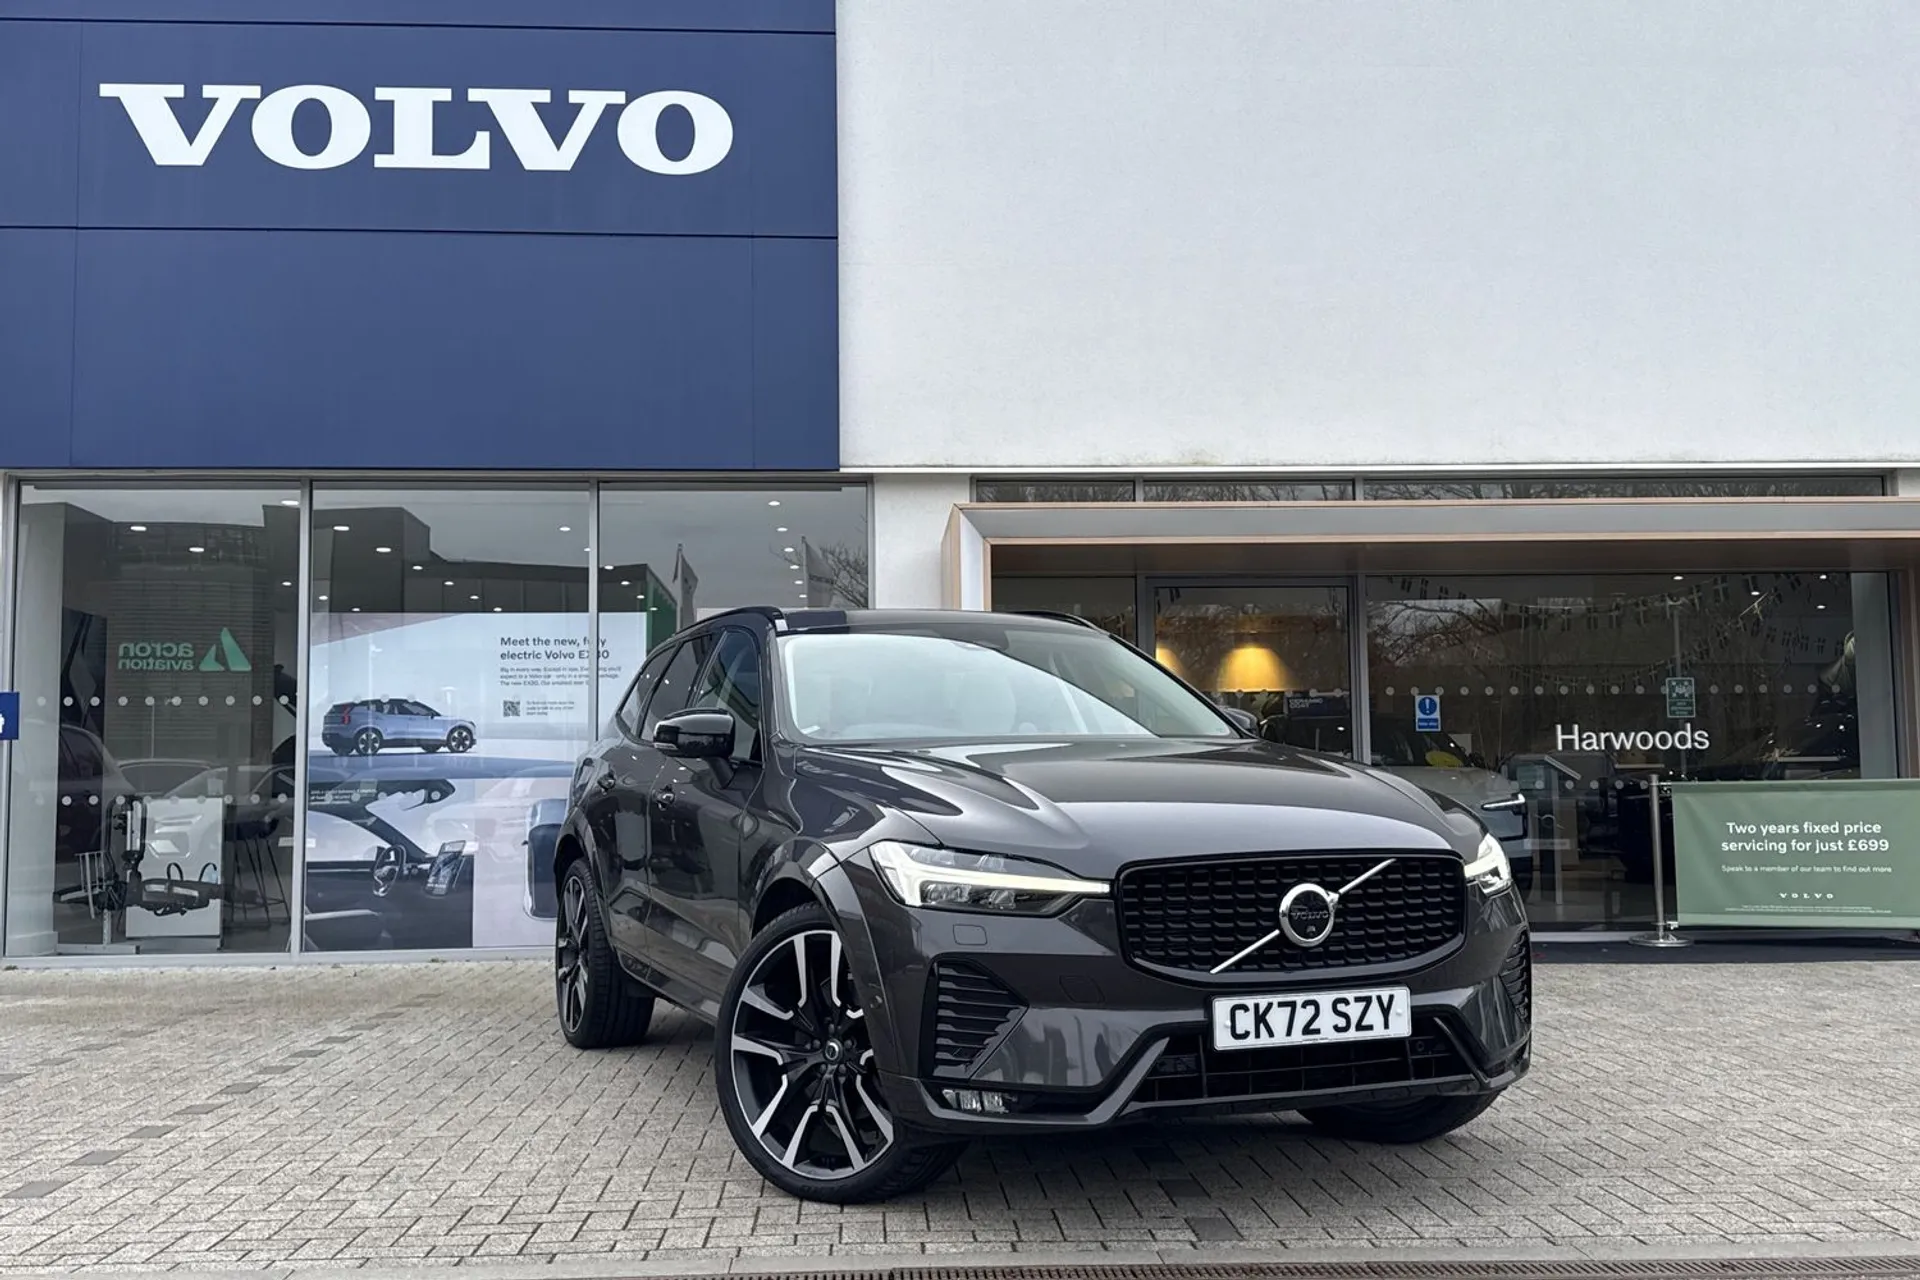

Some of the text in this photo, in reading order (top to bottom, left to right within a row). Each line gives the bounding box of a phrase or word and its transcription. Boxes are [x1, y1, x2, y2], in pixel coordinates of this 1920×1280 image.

[99, 83, 734, 176] VOLVO
[500, 637, 530, 646] Meet
[532, 637, 551, 646] the
[554, 638, 580, 647] new,
[500, 650, 542, 660] electric
[544, 650, 575, 660] Volvo
[1555, 722, 1710, 751] Harwoods
[1726, 821, 1882, 837] Two years fixed price
[1721, 839, 1889, 854] servicing for just £699
[1721, 865, 1744, 873] Speak
[1229, 994, 1395, 1041] CK72 SZY
